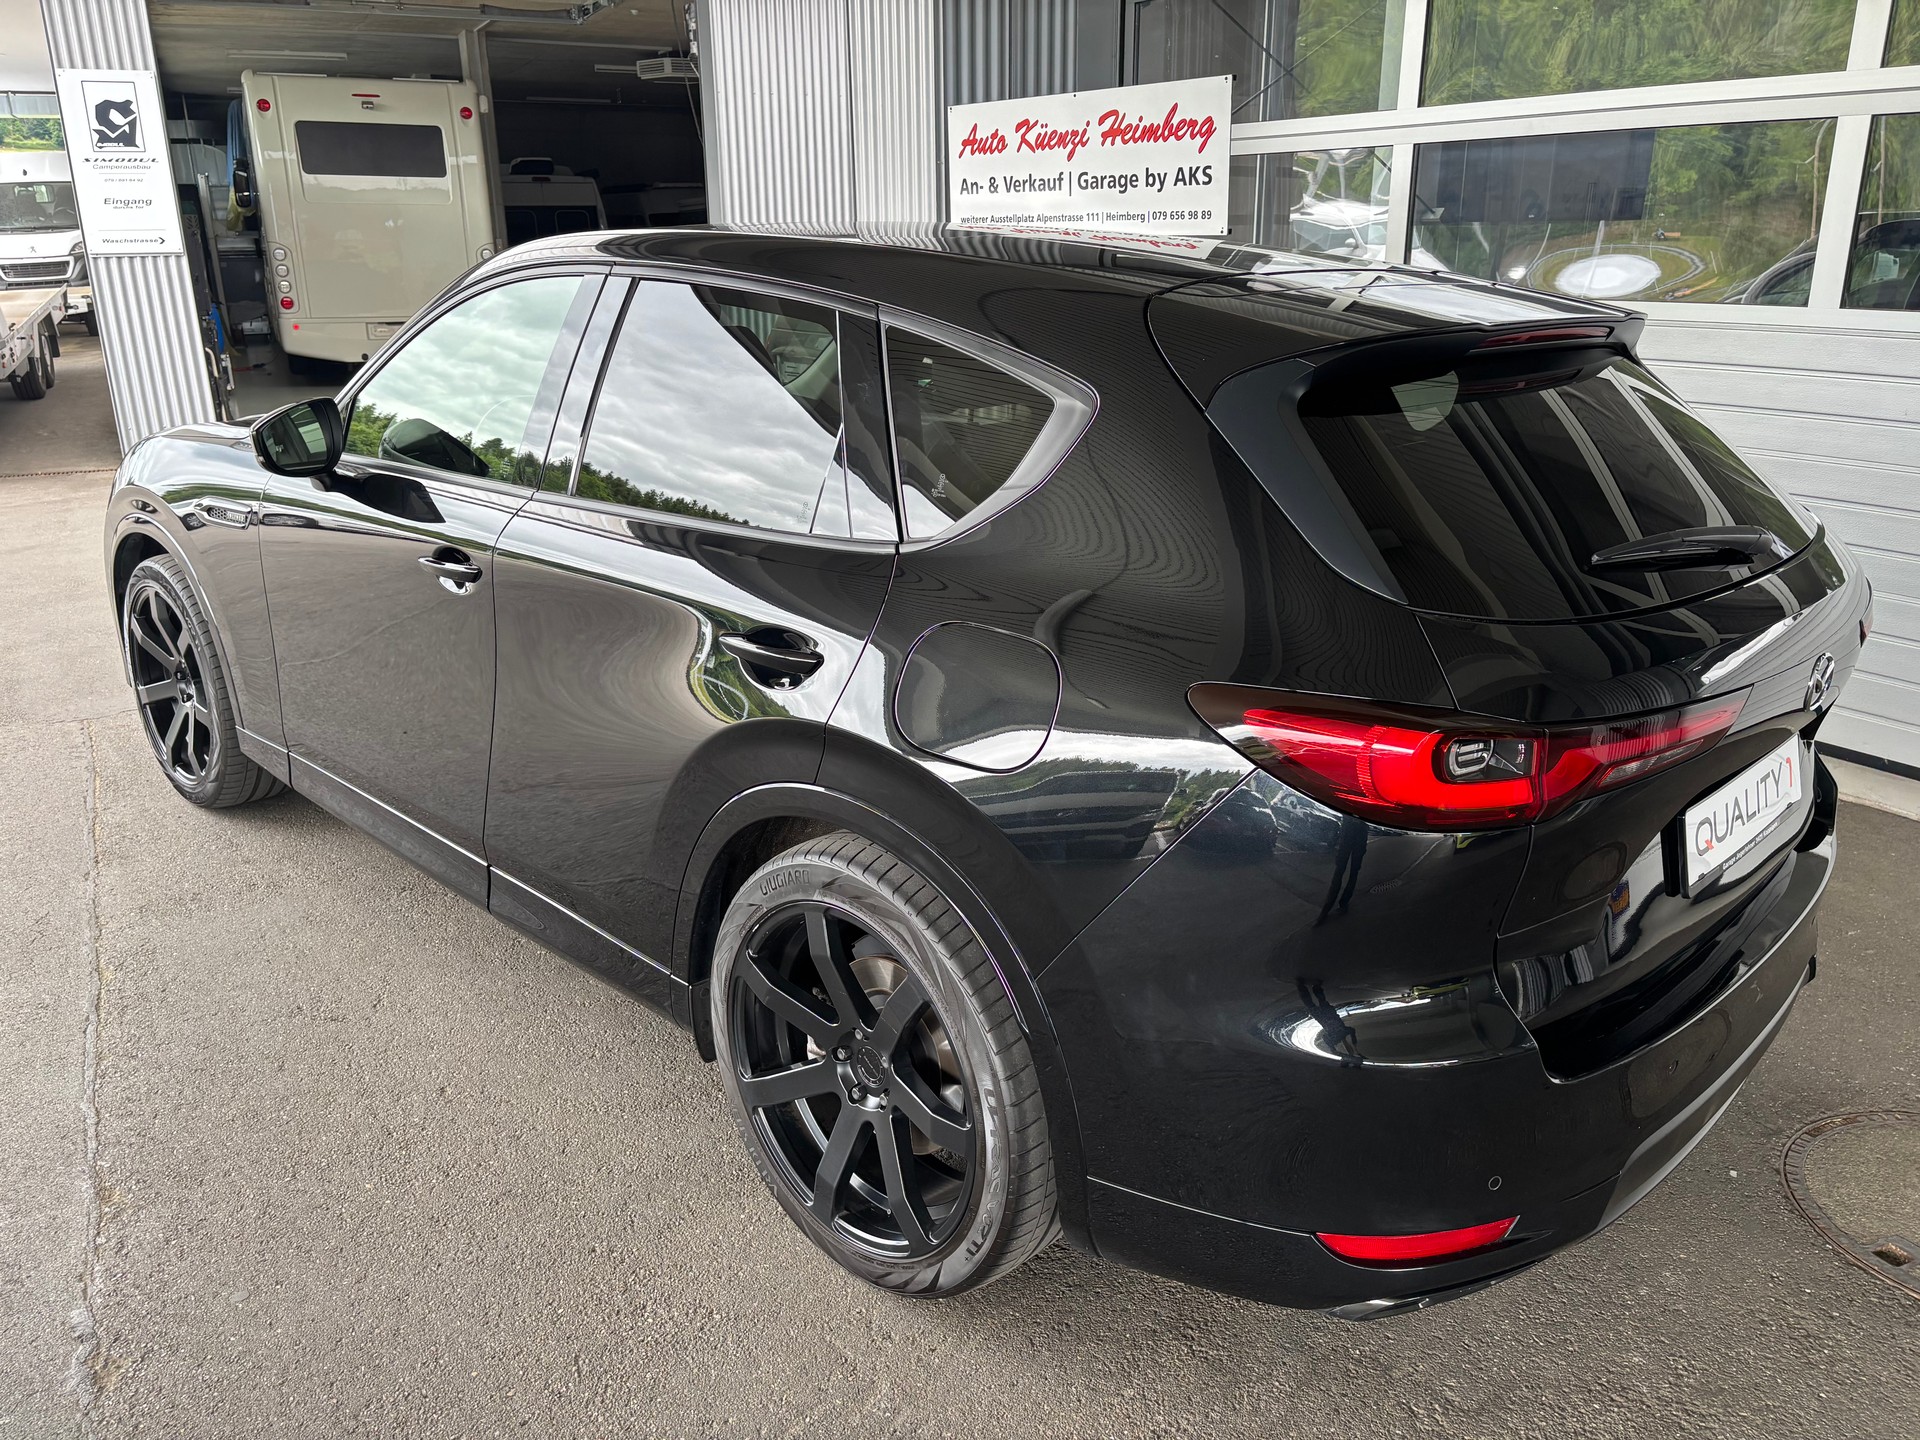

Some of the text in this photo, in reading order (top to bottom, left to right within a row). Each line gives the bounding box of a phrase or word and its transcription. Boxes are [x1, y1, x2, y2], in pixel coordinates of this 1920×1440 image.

[958, 102, 1217, 162] Auto Küenzi Heimberg
[960, 178, 984, 195] An-
[988, 176, 999, 194] &
[1003, 172, 1064, 193] Verkauf
[1077, 171, 1139, 194] Garage
[1145, 167, 1168, 193] by
[1173, 165, 1213, 187] AKS
[104, 198, 153, 206] Eingang
[960, 214, 988, 224] weiterer
[990, 213, 1034, 224] Ausstellplatz
[1036, 212, 1084, 224] Alpenstrasse
[1086, 213, 1100, 221] 111
[1105, 212, 1146, 223] Heimberg
[1152, 211, 1167, 220] 079
[1170, 211, 1185, 220] 656
[1188, 210, 1199, 220] 98
[1201, 210, 1212, 220] 89
[760, 869, 810, 896] GIUGIARO
